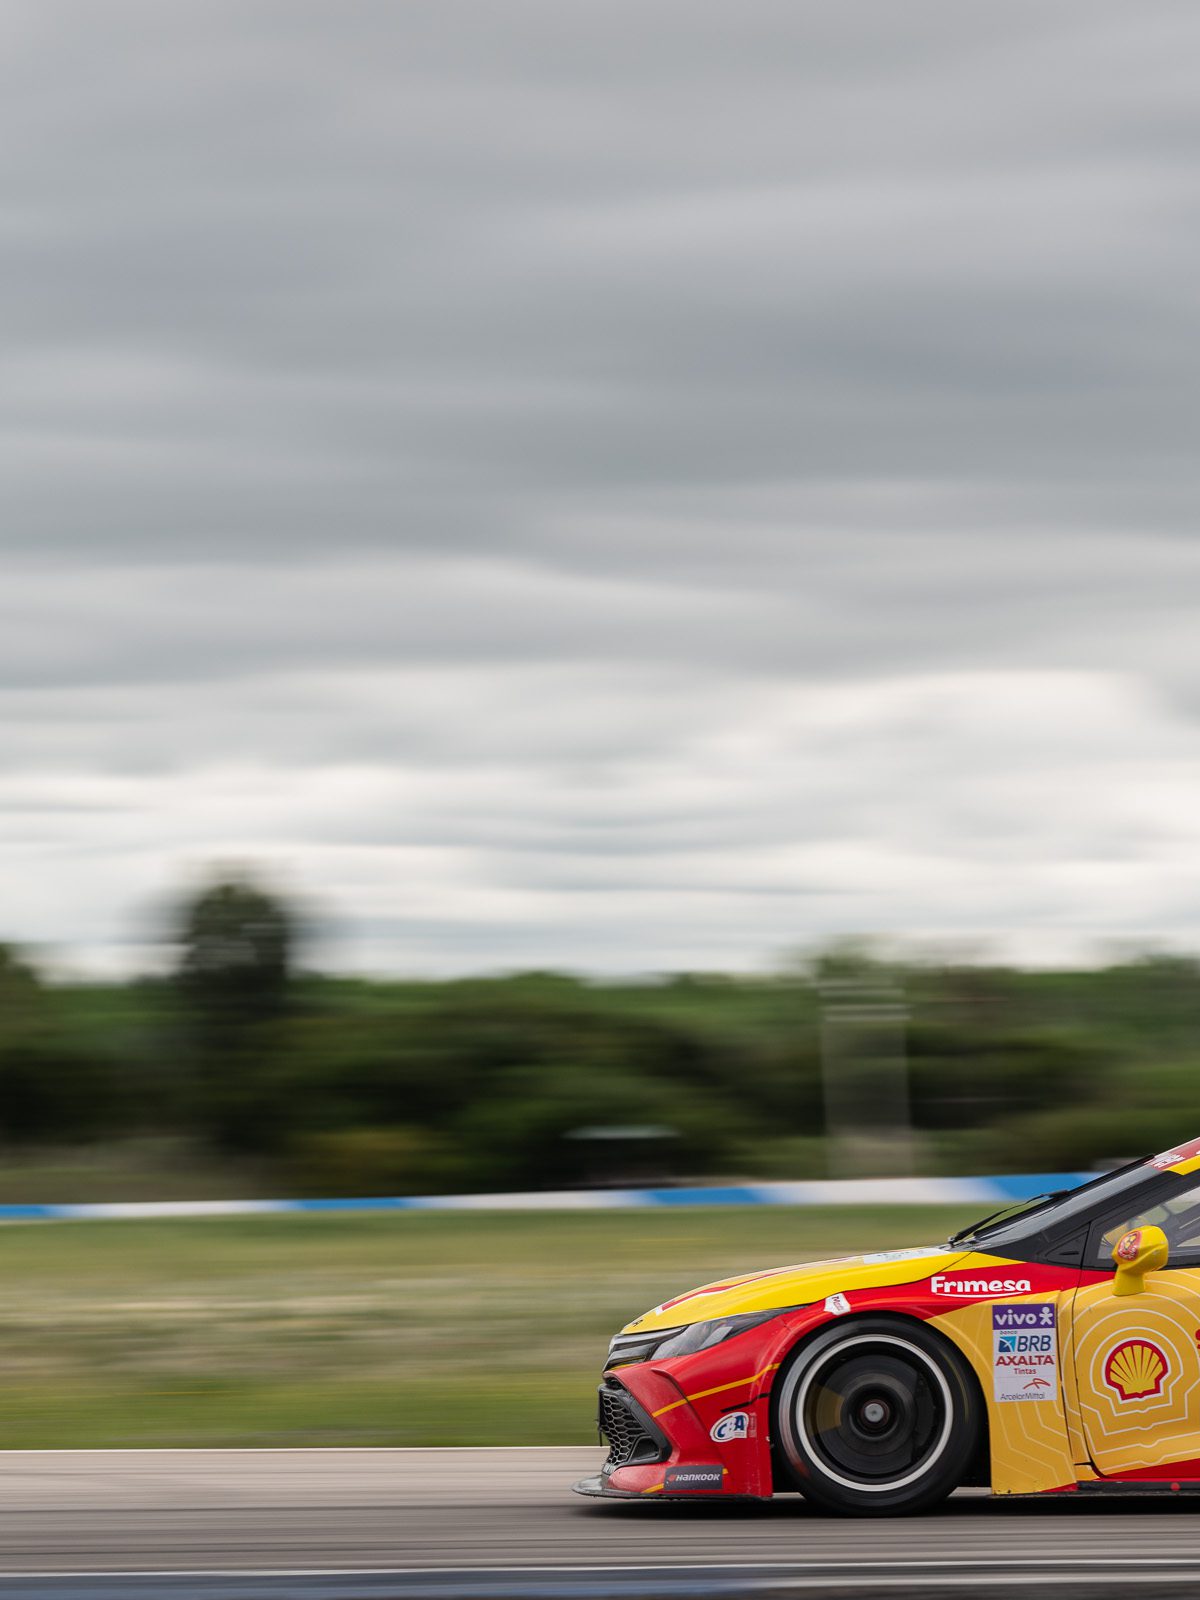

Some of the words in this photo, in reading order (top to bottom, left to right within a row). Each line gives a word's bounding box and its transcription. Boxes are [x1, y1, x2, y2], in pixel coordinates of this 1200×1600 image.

[930, 1275, 1032, 1294] Frimesa
[994, 1308, 1037, 1326] vivo
[1017, 1335, 1052, 1353] BRB
[995, 1355, 1055, 1367] AXALTA
[1013, 1367, 1037, 1375] Tintas
